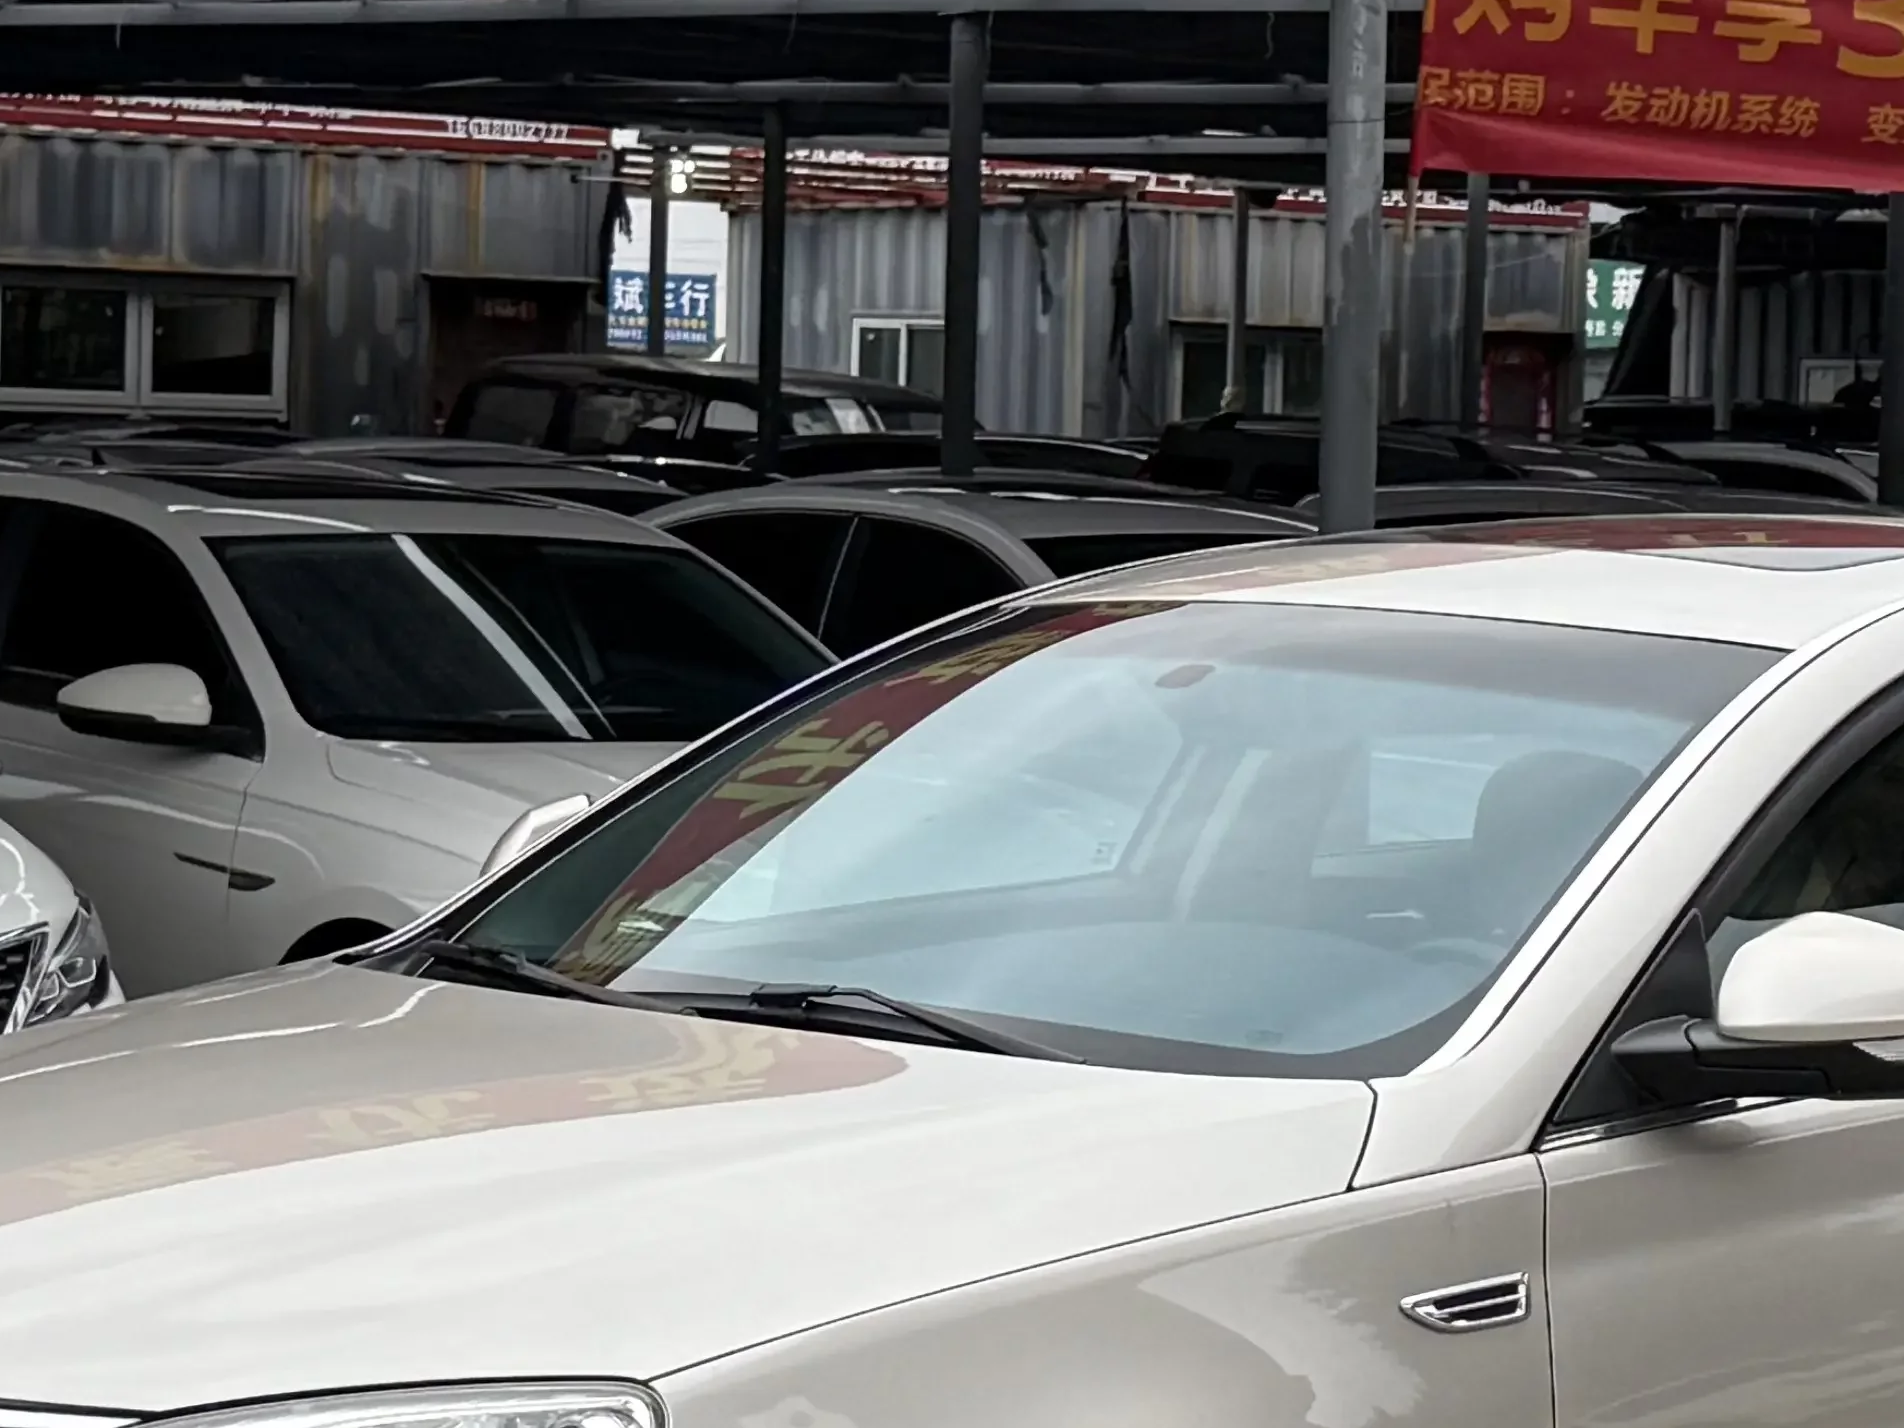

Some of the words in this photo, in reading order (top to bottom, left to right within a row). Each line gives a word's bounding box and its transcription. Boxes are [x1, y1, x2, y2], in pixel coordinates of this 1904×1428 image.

[1599, 80, 1822, 138] 发动机系统
